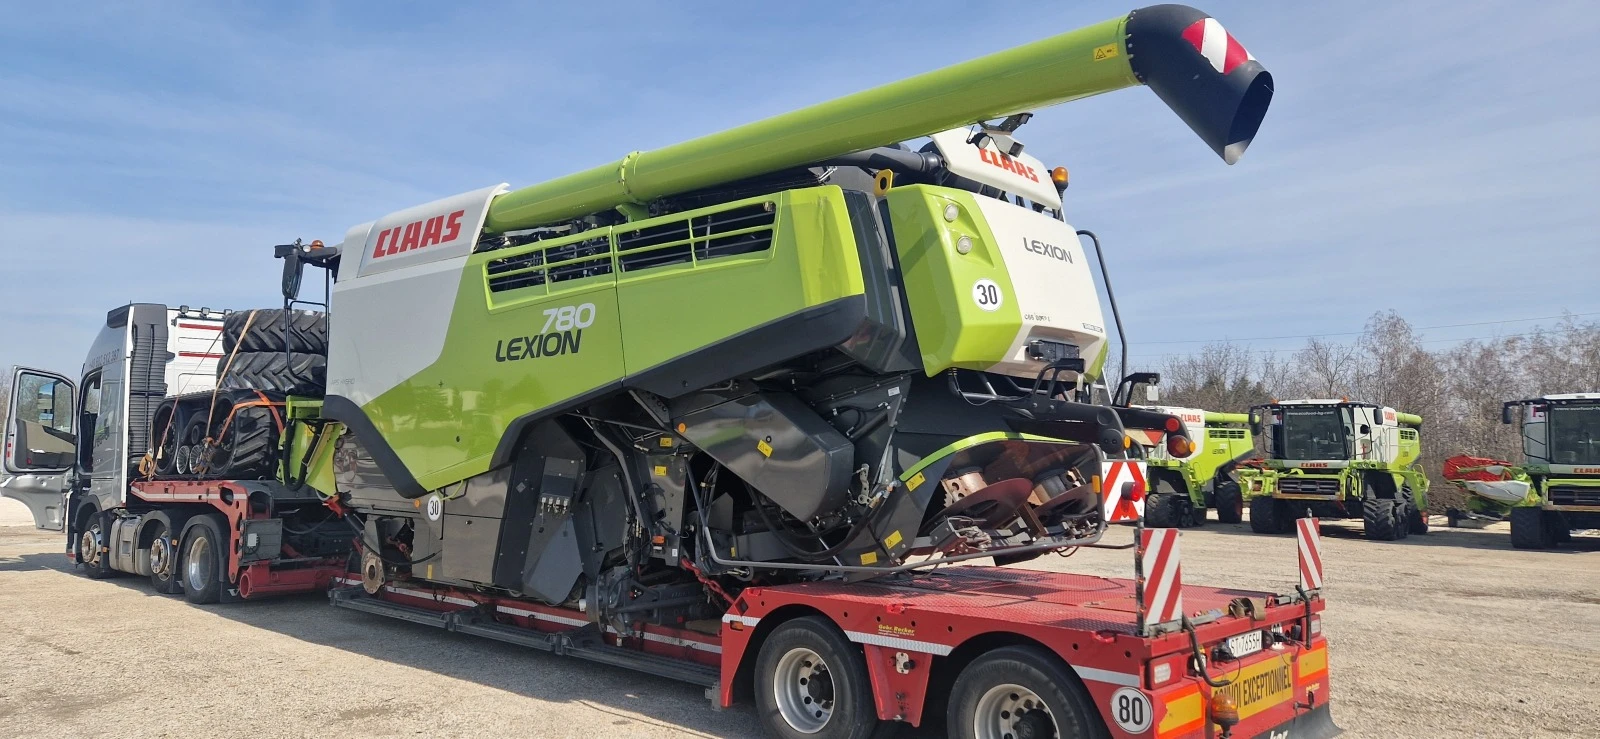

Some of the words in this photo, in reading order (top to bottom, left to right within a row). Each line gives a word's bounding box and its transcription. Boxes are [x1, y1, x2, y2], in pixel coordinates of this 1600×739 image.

[979, 148, 1039, 183] CLAAS
[372, 210, 464, 258] CLAAS
[1023, 237, 1073, 264] LEXION
[977, 284, 998, 305] 30
[540, 302, 596, 334] 780
[495, 328, 582, 362] LEXION
[430, 500, 439, 516] 30
[1231, 638, 1240, 654] ST
[1244, 665, 1291, 706] EXCEPTIONNEL
[1119, 695, 1144, 725] 80
